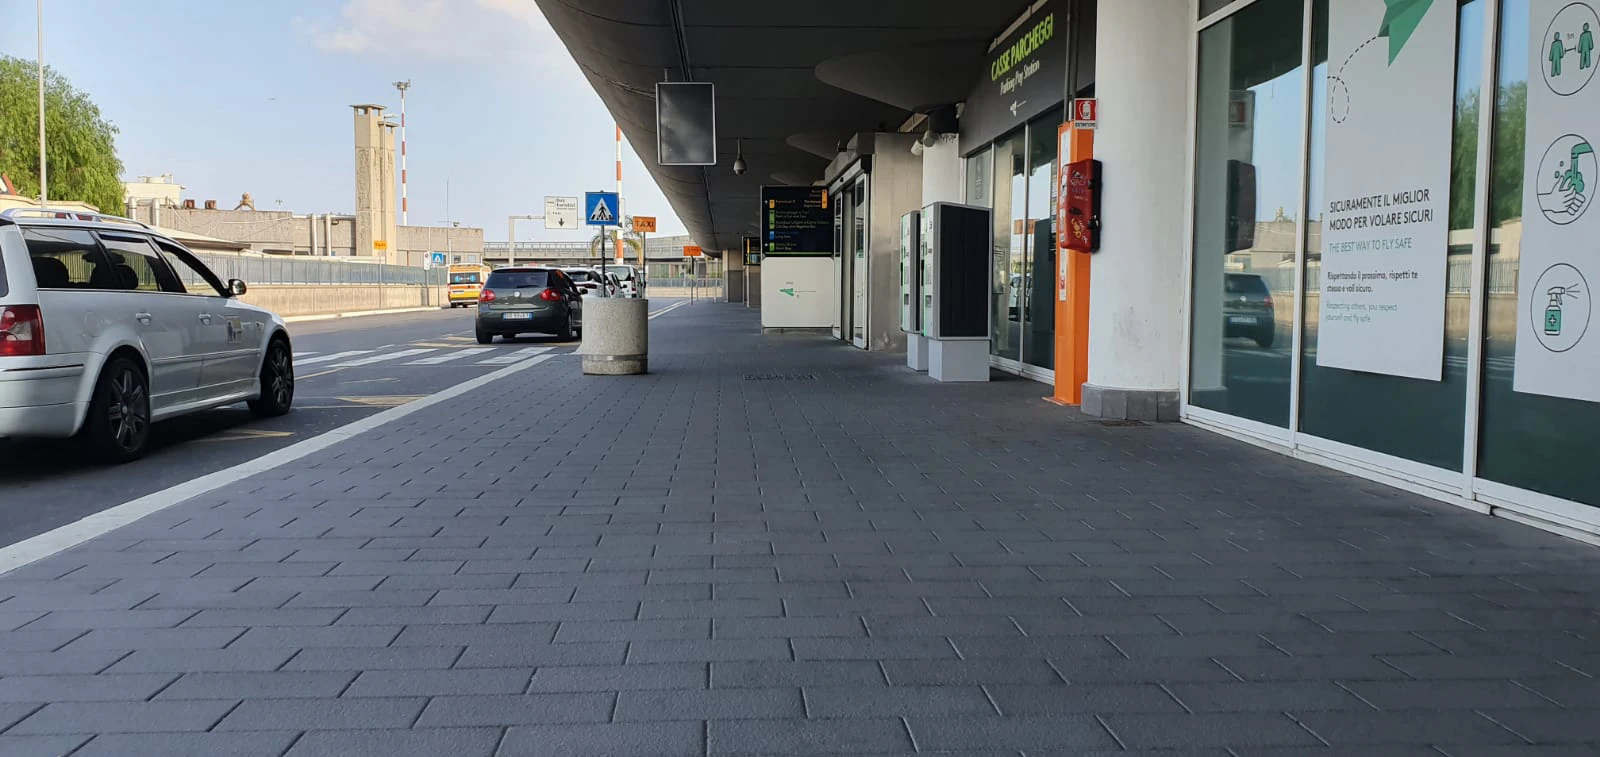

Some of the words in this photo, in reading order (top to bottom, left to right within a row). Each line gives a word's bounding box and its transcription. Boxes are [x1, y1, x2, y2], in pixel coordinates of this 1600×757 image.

[991, 48, 1011, 81] CASSE
[1010, 12, 1054, 68] PARCHEGGI
[1000, 77, 1015, 96] Parking
[1023, 59, 1040, 80] Station
[1329, 195, 1382, 213] SICURAMENTE
[1383, 194, 1391, 207] IL
[1392, 188, 1430, 206] MIGLIOR
[636, 220, 654, 228] TAXI
[1329, 217, 1353, 231] MODO
[1353, 215, 1368, 229] PER
[1369, 212, 1402, 227] VOLARE
[1403, 208, 1433, 224] SICURI
[1329, 242, 1340, 253] THE
[1340, 241, 1354, 253] BEST
[1355, 240, 1371, 252] WAY
[1371, 239, 1380, 251] TO
[1382, 238, 1394, 250] FLY
[1394, 237, 1412, 249] SAFE
[1388, 269, 1411, 282] rispetti
[1411, 271, 1418, 279] te
